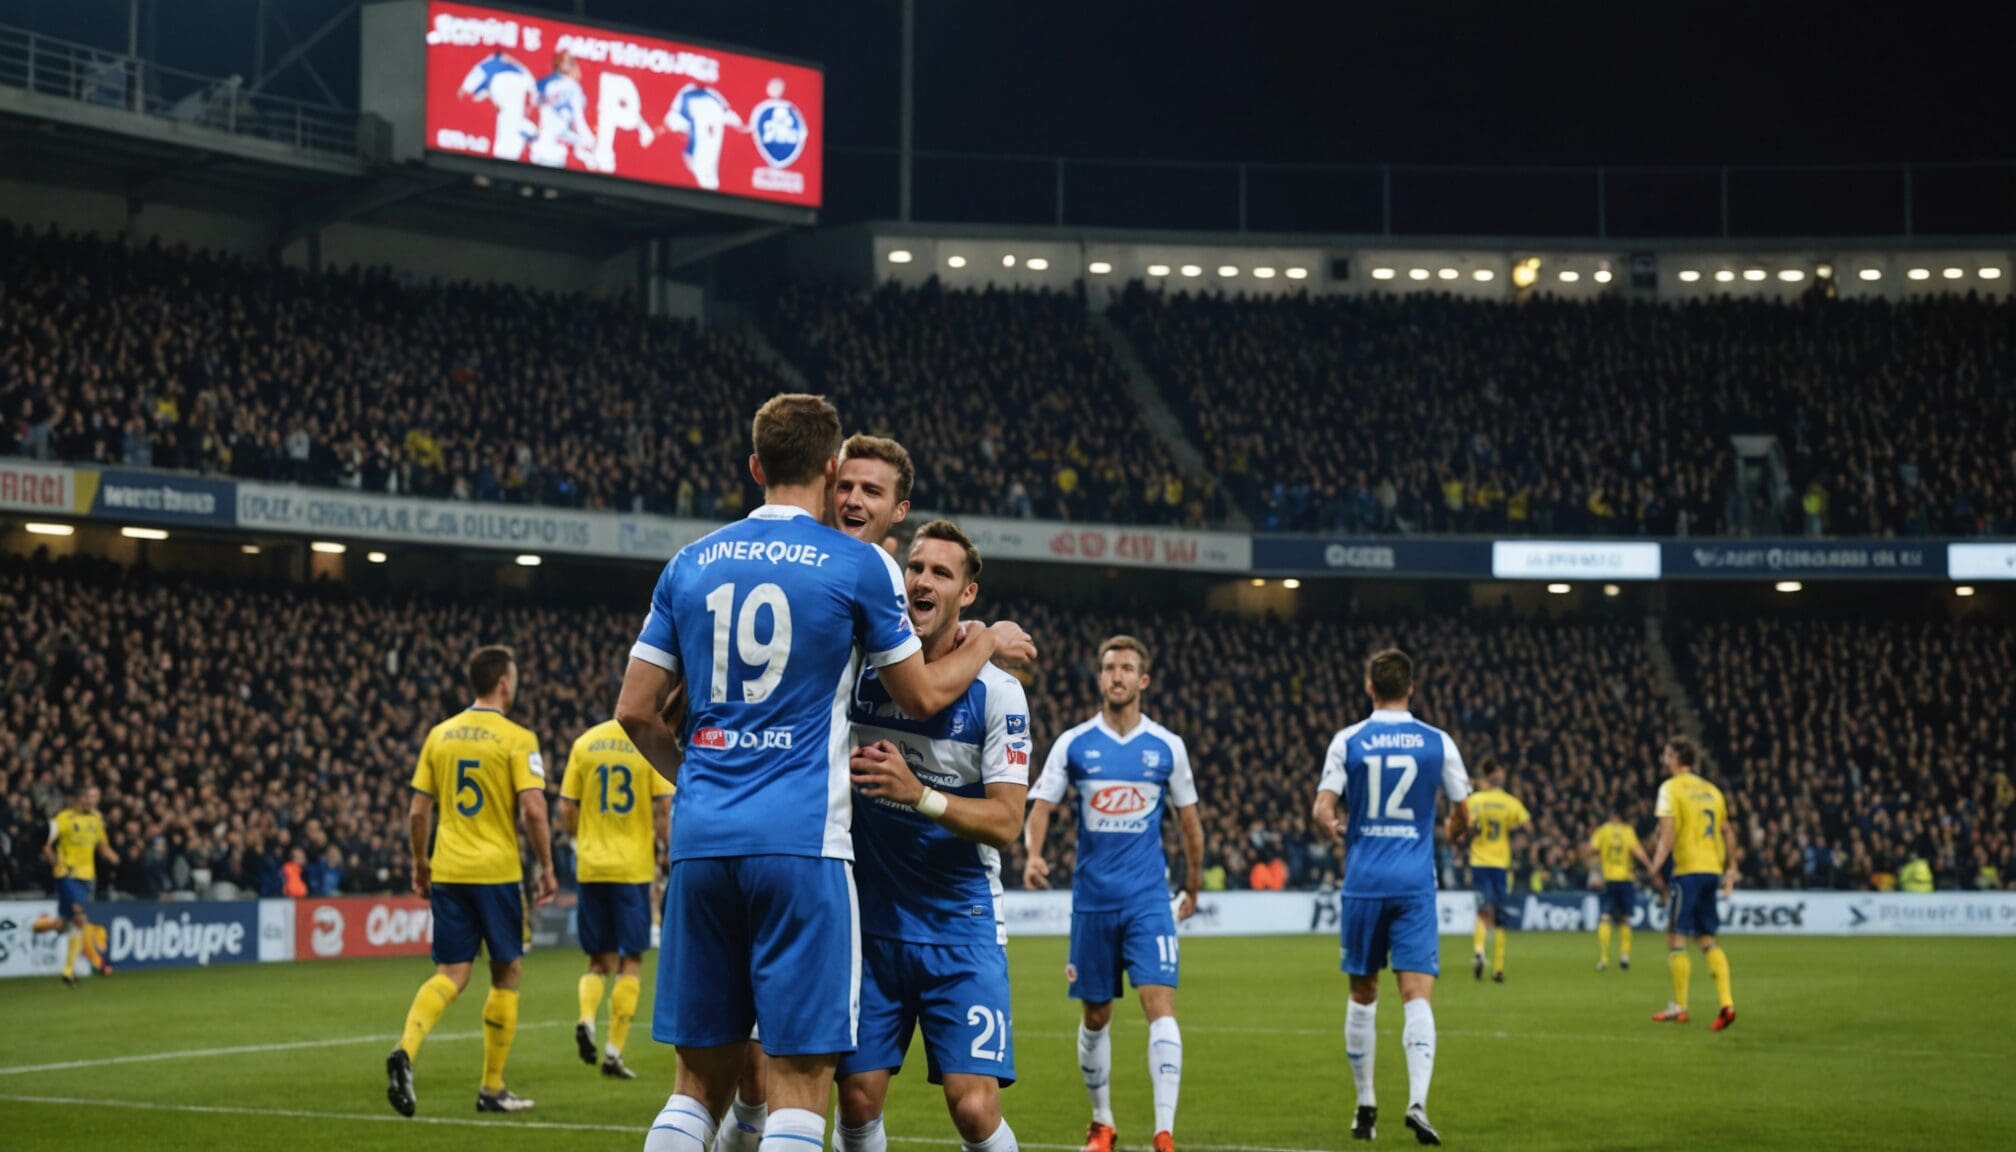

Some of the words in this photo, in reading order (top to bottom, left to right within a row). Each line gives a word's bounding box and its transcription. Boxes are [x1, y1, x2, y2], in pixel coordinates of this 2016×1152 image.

[706, 582, 792, 704] 19
[456, 759, 484, 817] 5
[595, 764, 635, 814] 13
[1363, 754, 1418, 820] 12
